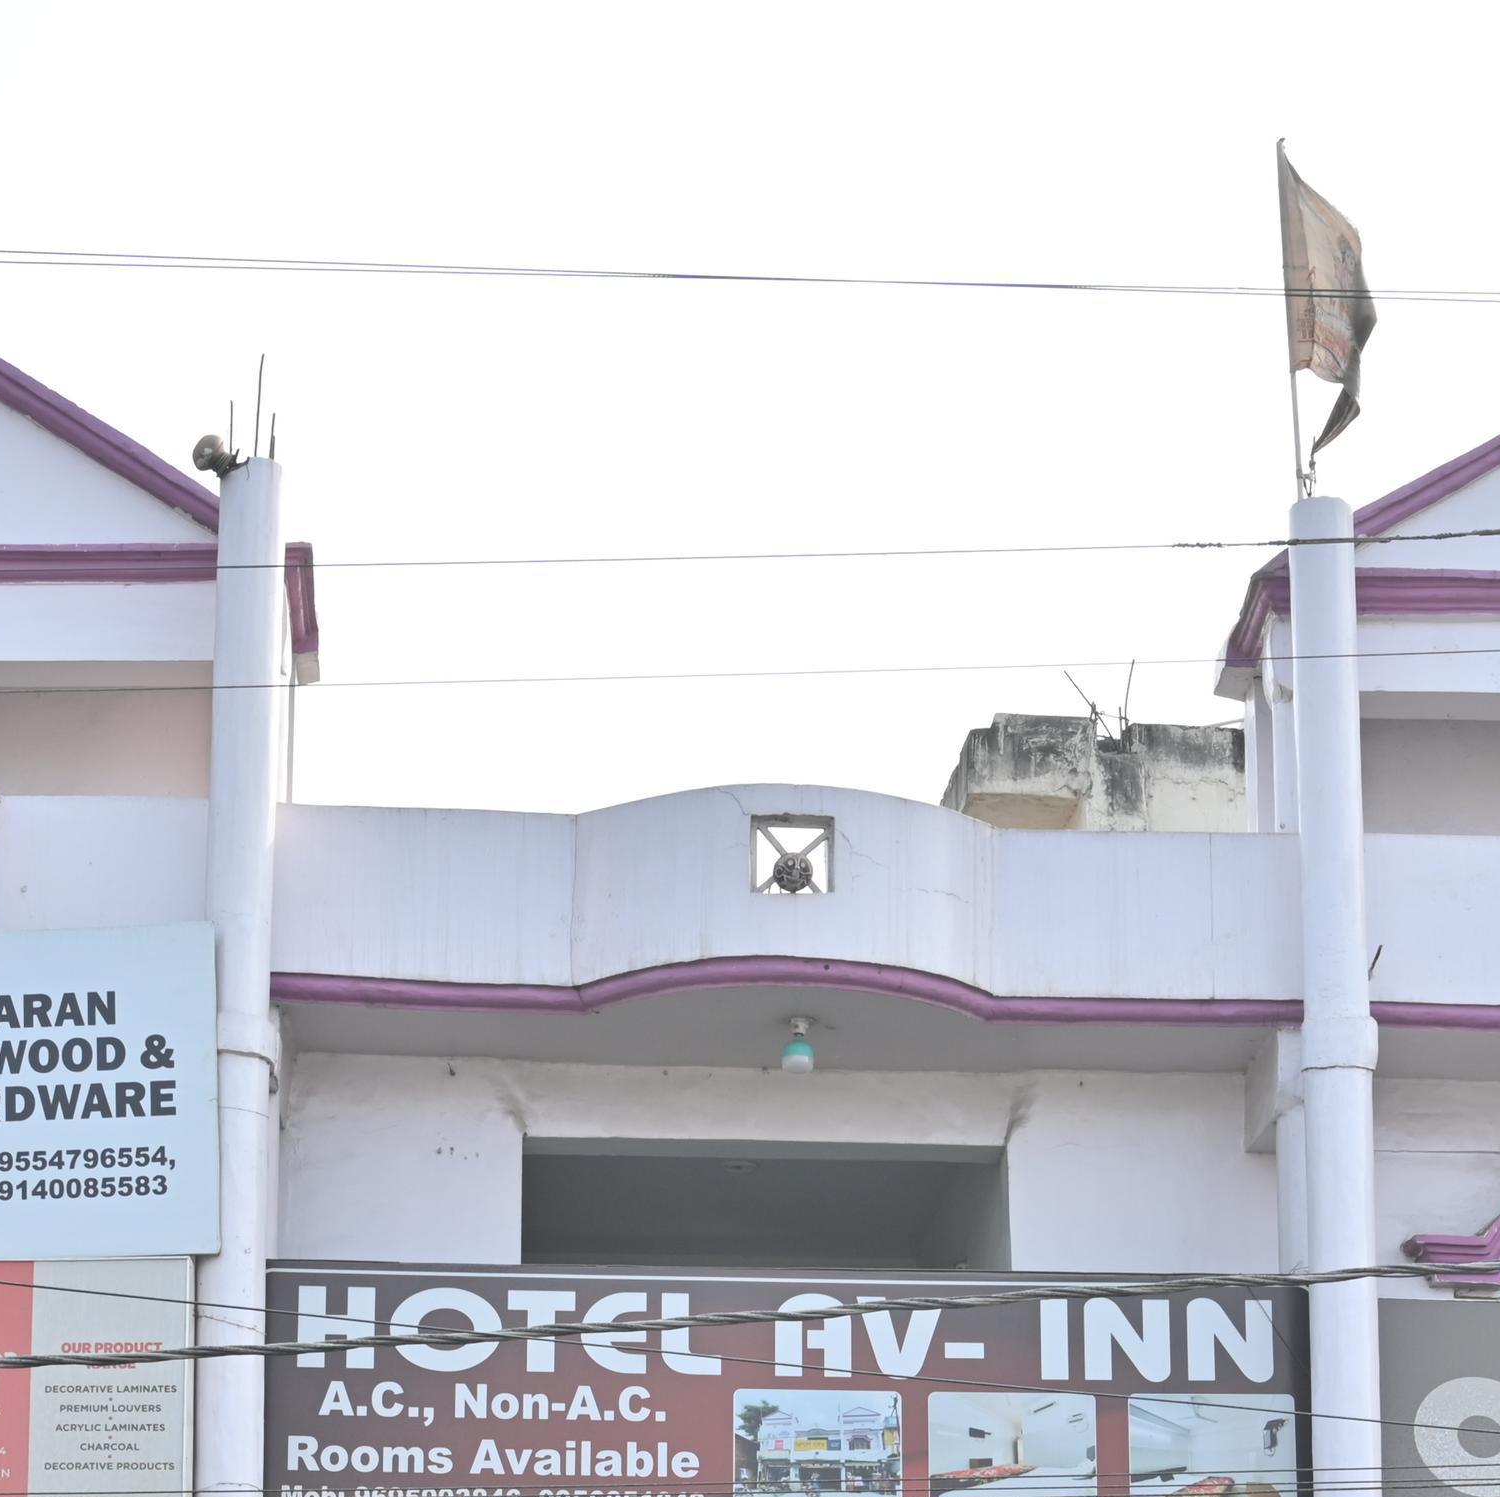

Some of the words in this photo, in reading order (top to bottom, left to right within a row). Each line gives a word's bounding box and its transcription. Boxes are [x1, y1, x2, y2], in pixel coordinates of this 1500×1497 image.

[141, 1034, 175, 1069] &
[296, 1286, 720, 1375] HOTEL
[1041, 1297, 1274, 1382] INN
[45, 1384, 112, 1394] DECORATIVE
[115, 1384, 177, 1394] LAMINATES
[318, 1381, 434, 1425] A.C.,
[455, 1384, 666, 1422] Non-A.C.
[60, 1404, 108, 1413] PREMIUM
[112, 1404, 161, 1413] LOUVERS
[55, 1423, 99, 1433] ACRYLIC
[103, 1423, 165, 1433] LAMINATES
[80, 1442, 139, 1452] CHARCOAL
[287, 1436, 453, 1474] Rooms
[470, 1439, 699, 1477] Available
[44, 1462, 110, 1471] DECORATIVE
[114, 1462, 175, 1471] PRODUCTS
